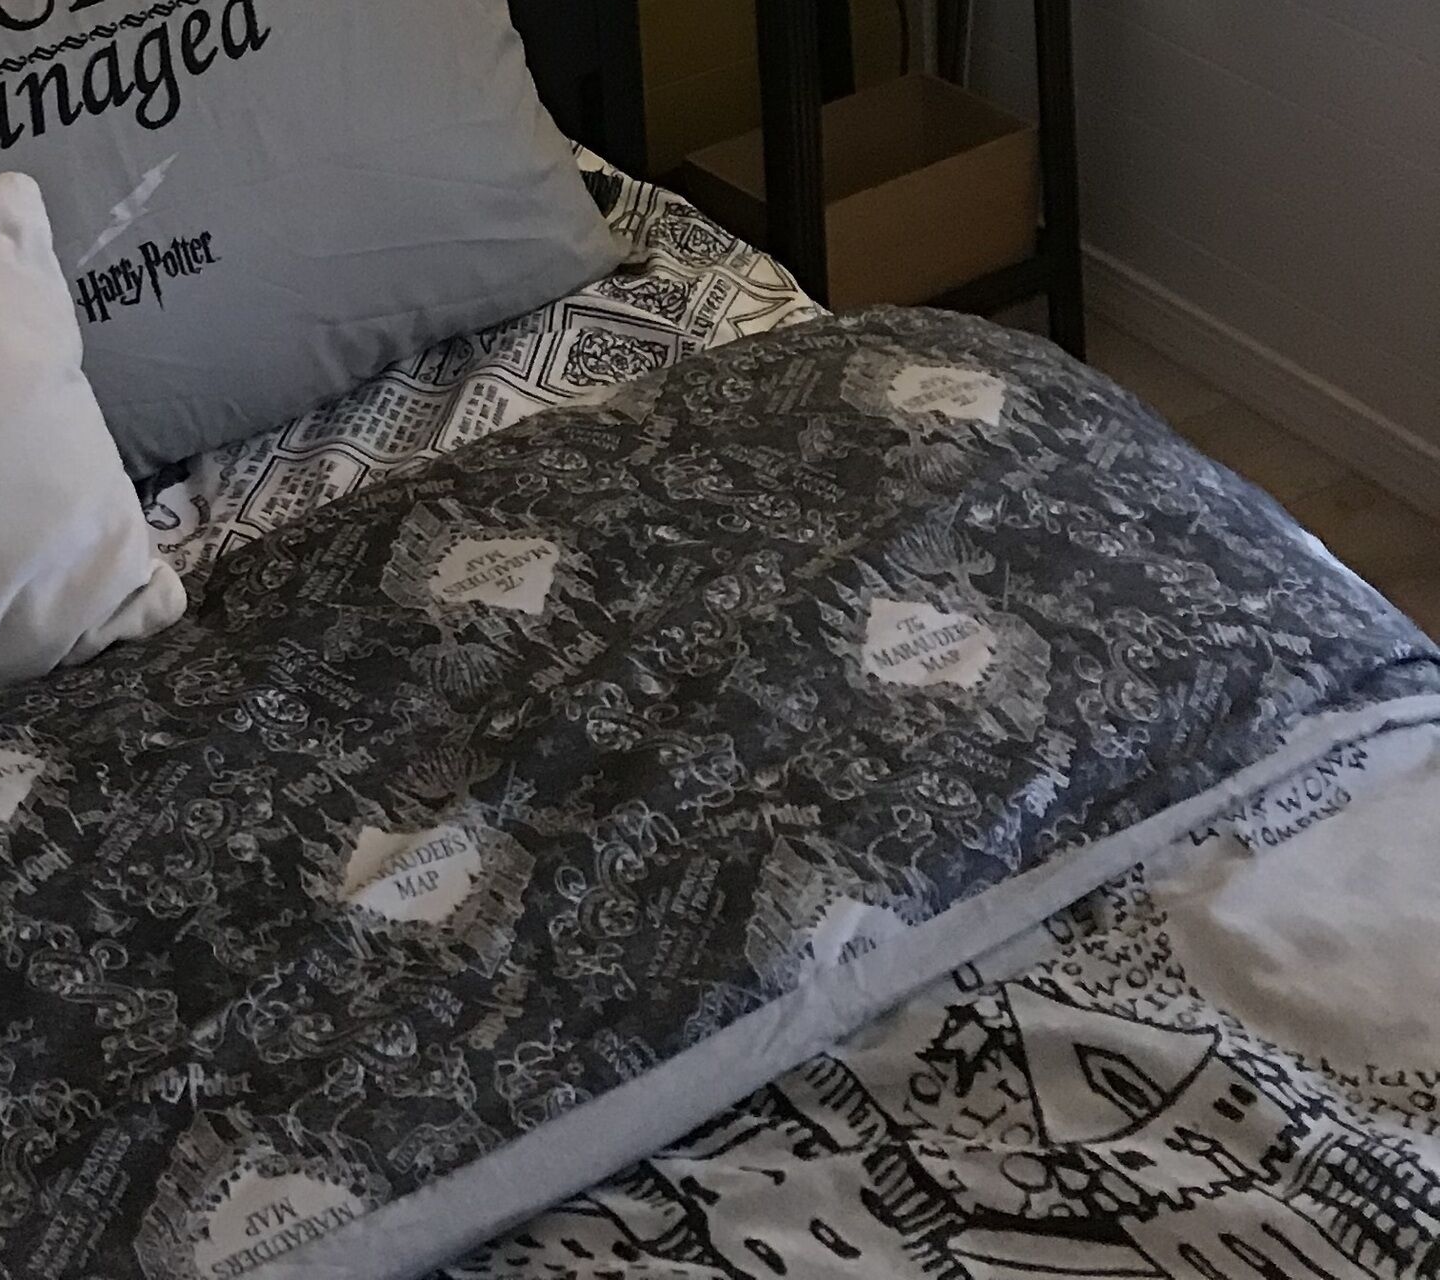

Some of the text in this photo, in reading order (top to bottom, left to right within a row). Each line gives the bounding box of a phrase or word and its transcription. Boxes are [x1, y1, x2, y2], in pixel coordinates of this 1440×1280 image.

[77, 231, 215, 323] Harry Potter
[465, 545, 511, 573] MAP
[896, 616, 926, 635] The
[919, 647, 963, 673] MAP
[396, 870, 441, 901] MAP
[245, 1197, 297, 1237] MAP
